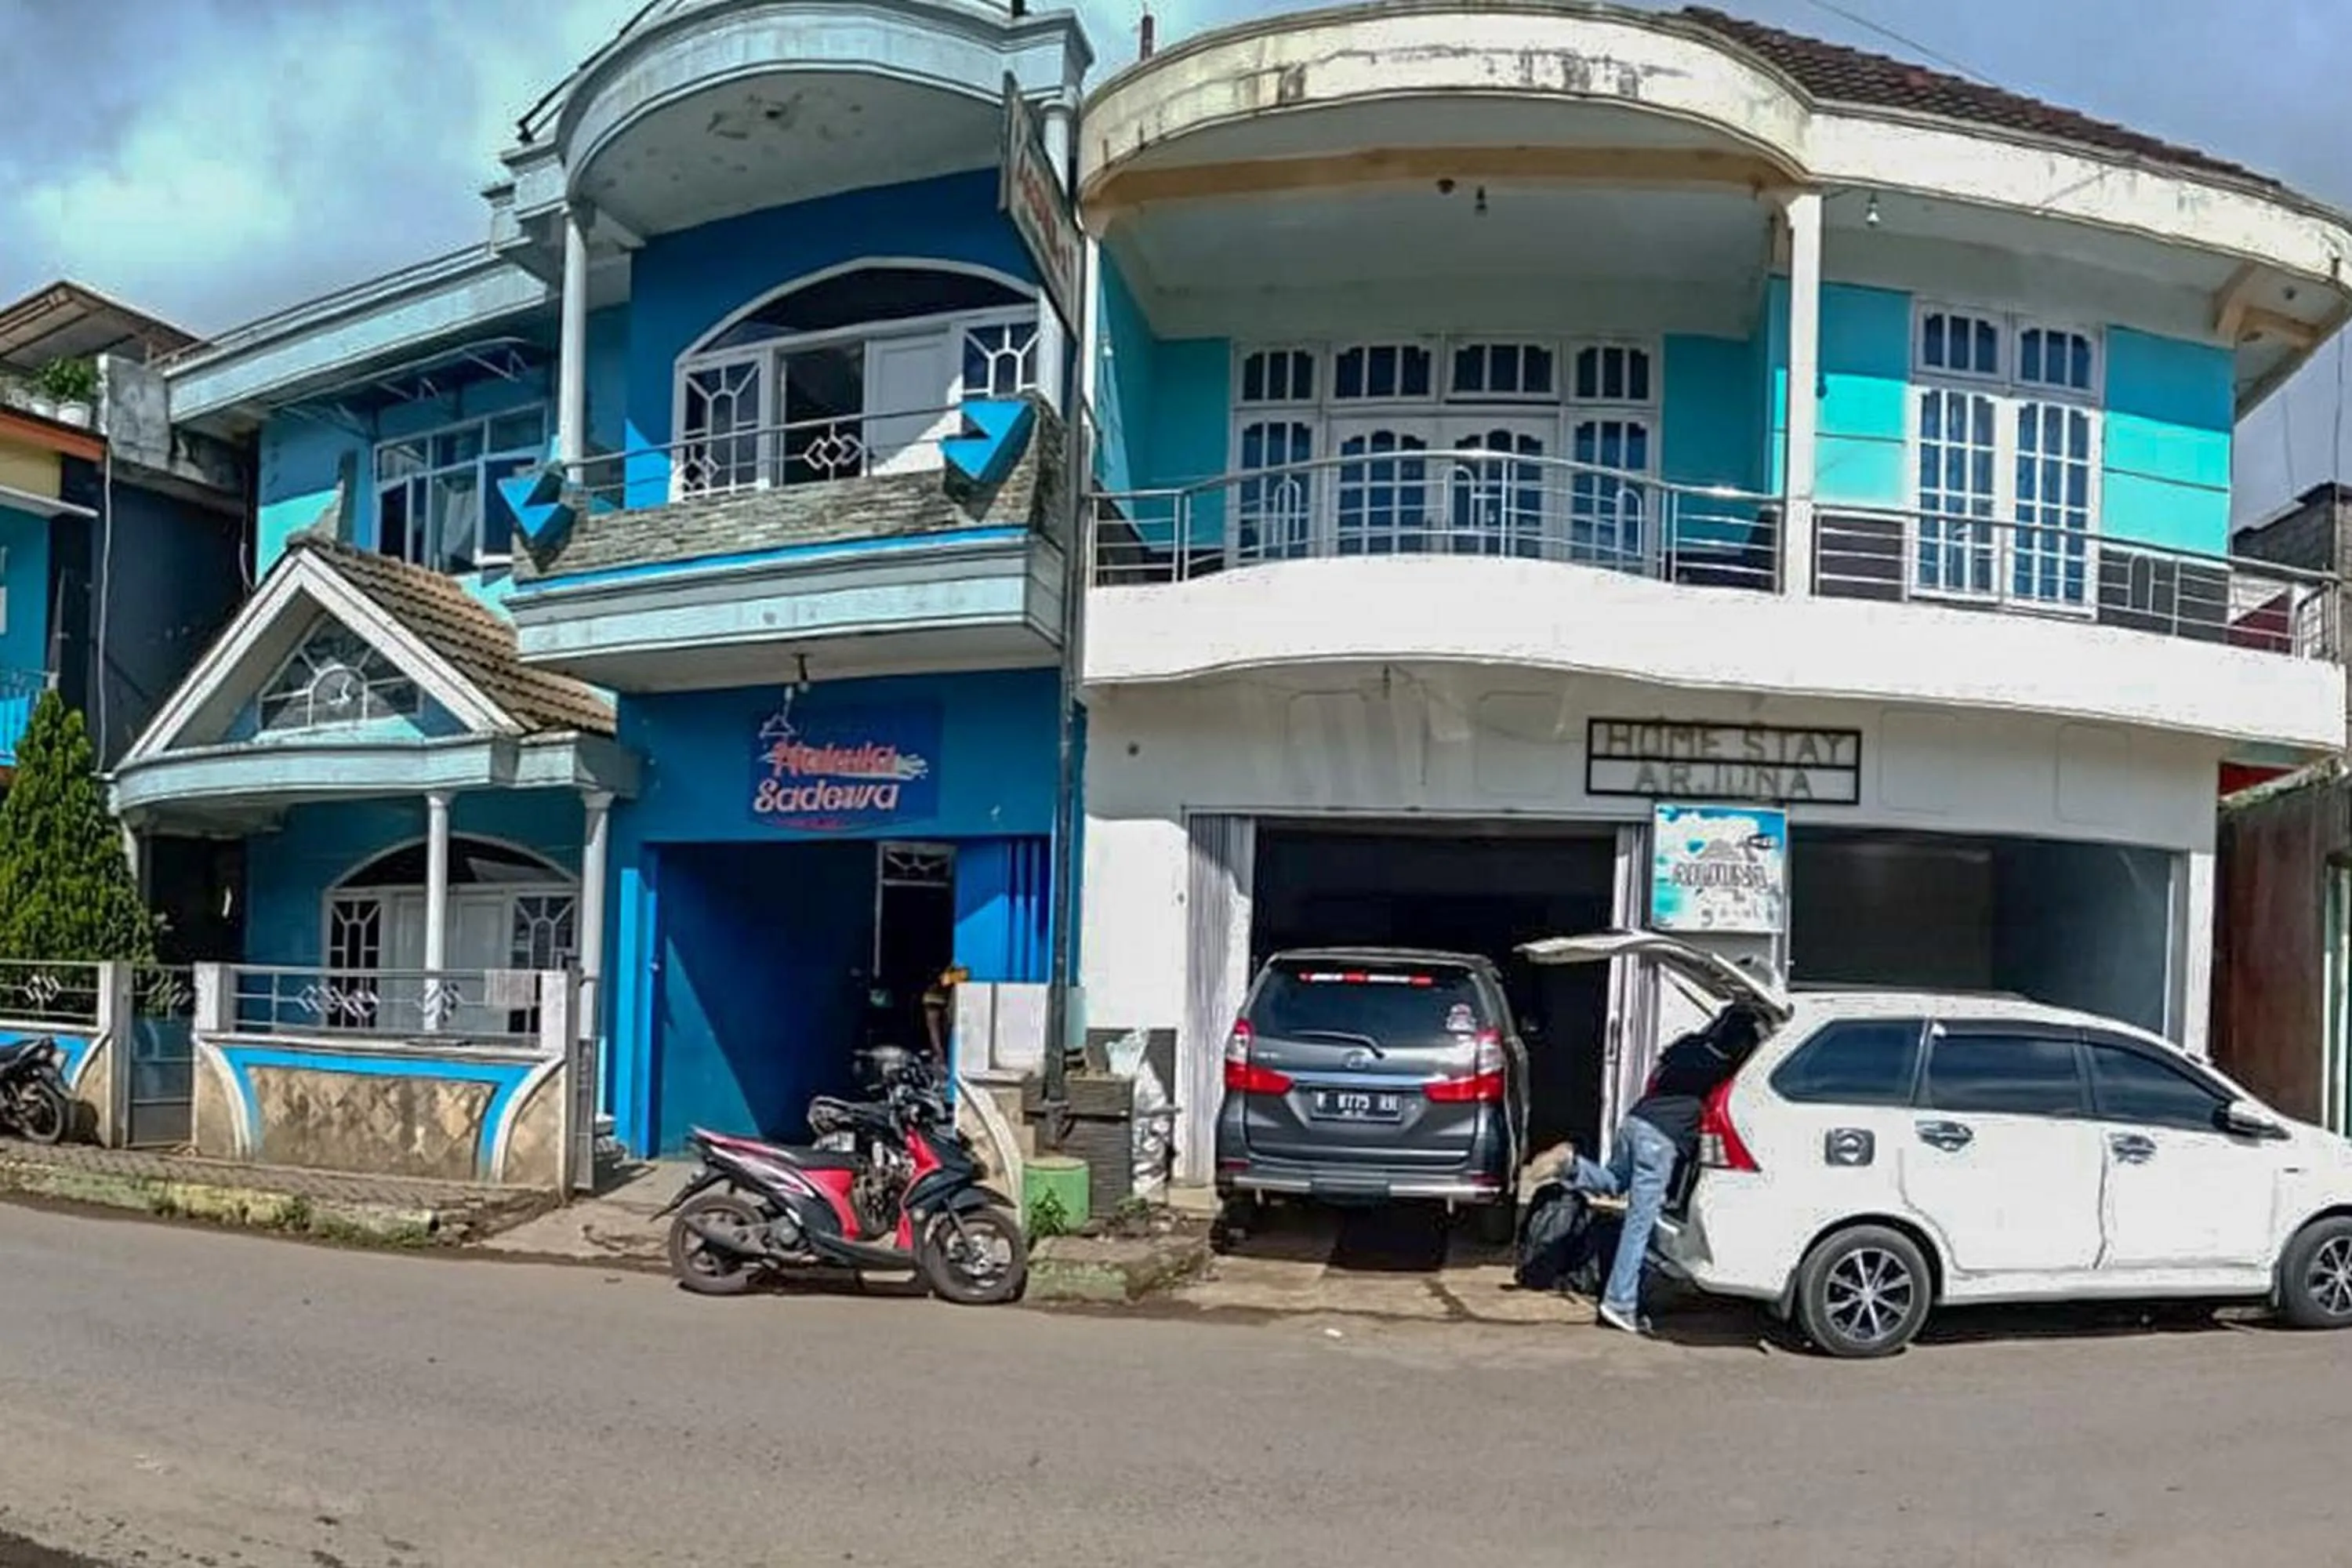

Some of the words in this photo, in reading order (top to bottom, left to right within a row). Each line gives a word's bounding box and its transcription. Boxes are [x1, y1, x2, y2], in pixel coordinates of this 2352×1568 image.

[1607, 720, 1719, 760] HOME
[1743, 724, 1843, 765] STAY
[753, 778, 901, 814] Sadewa
[1635, 760, 1813, 799] ARJUNA
